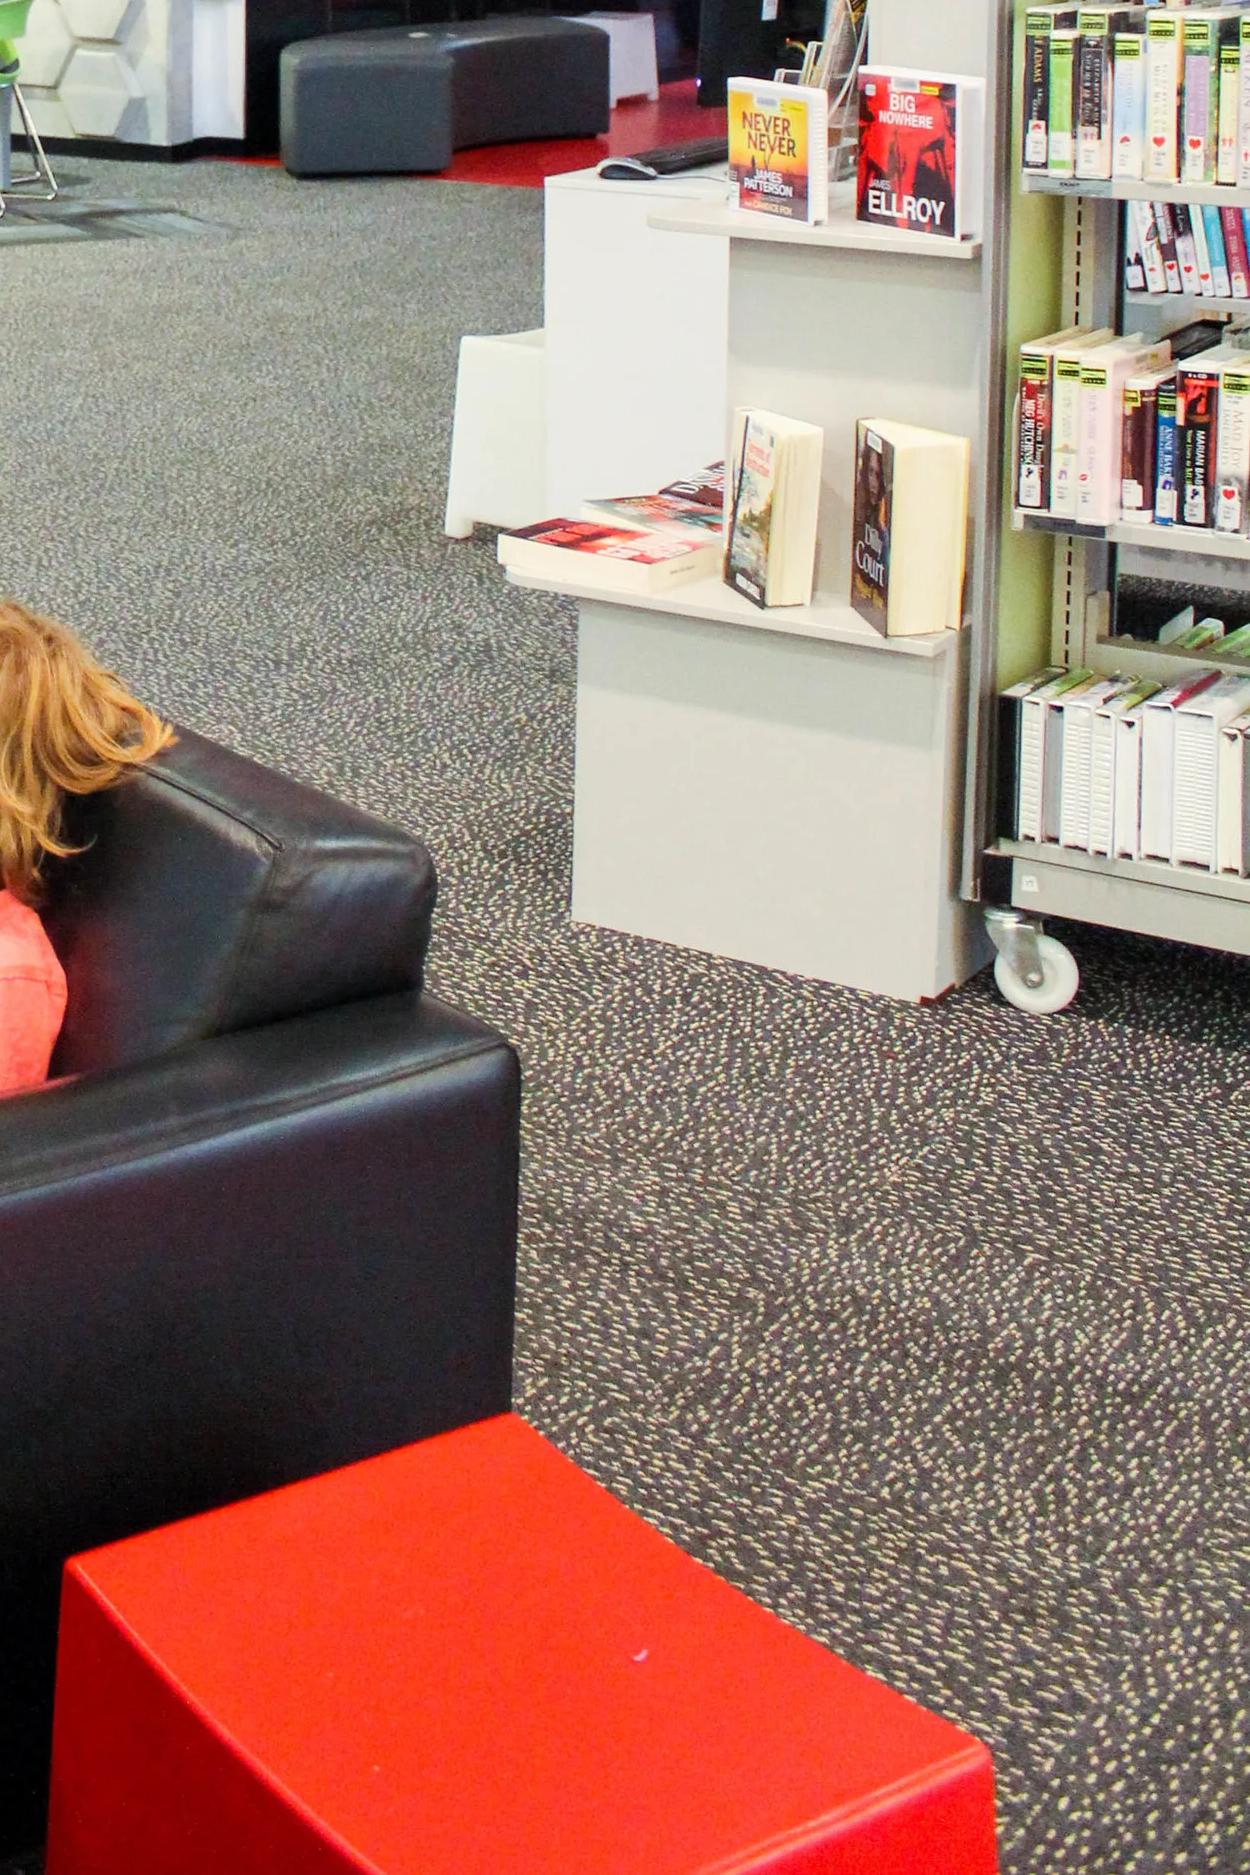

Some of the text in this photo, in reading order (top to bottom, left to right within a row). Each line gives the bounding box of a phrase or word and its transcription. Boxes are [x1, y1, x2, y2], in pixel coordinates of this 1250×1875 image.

[1033, 47, 1043, 83] ADAMS
[889, 92, 917, 114] BIG
[742, 111, 791, 137] NEVER
[878, 110, 934, 130] NOWHERE
[747, 132, 797, 158] NEVER
[743, 176, 794, 198] PATTERSON
[754, 168, 783, 185] JAMES
[869, 178, 891, 189] JAMES
[868, 189, 946, 225] ELLROY
[1024, 399, 1035, 466] MEG HUTCHINSO
[1036, 421, 1046, 442] Own
[1164, 425, 1174, 451] ANNE
[1194, 430, 1206, 485] MARIAN BAB
[855, 540, 885, 587] Court
